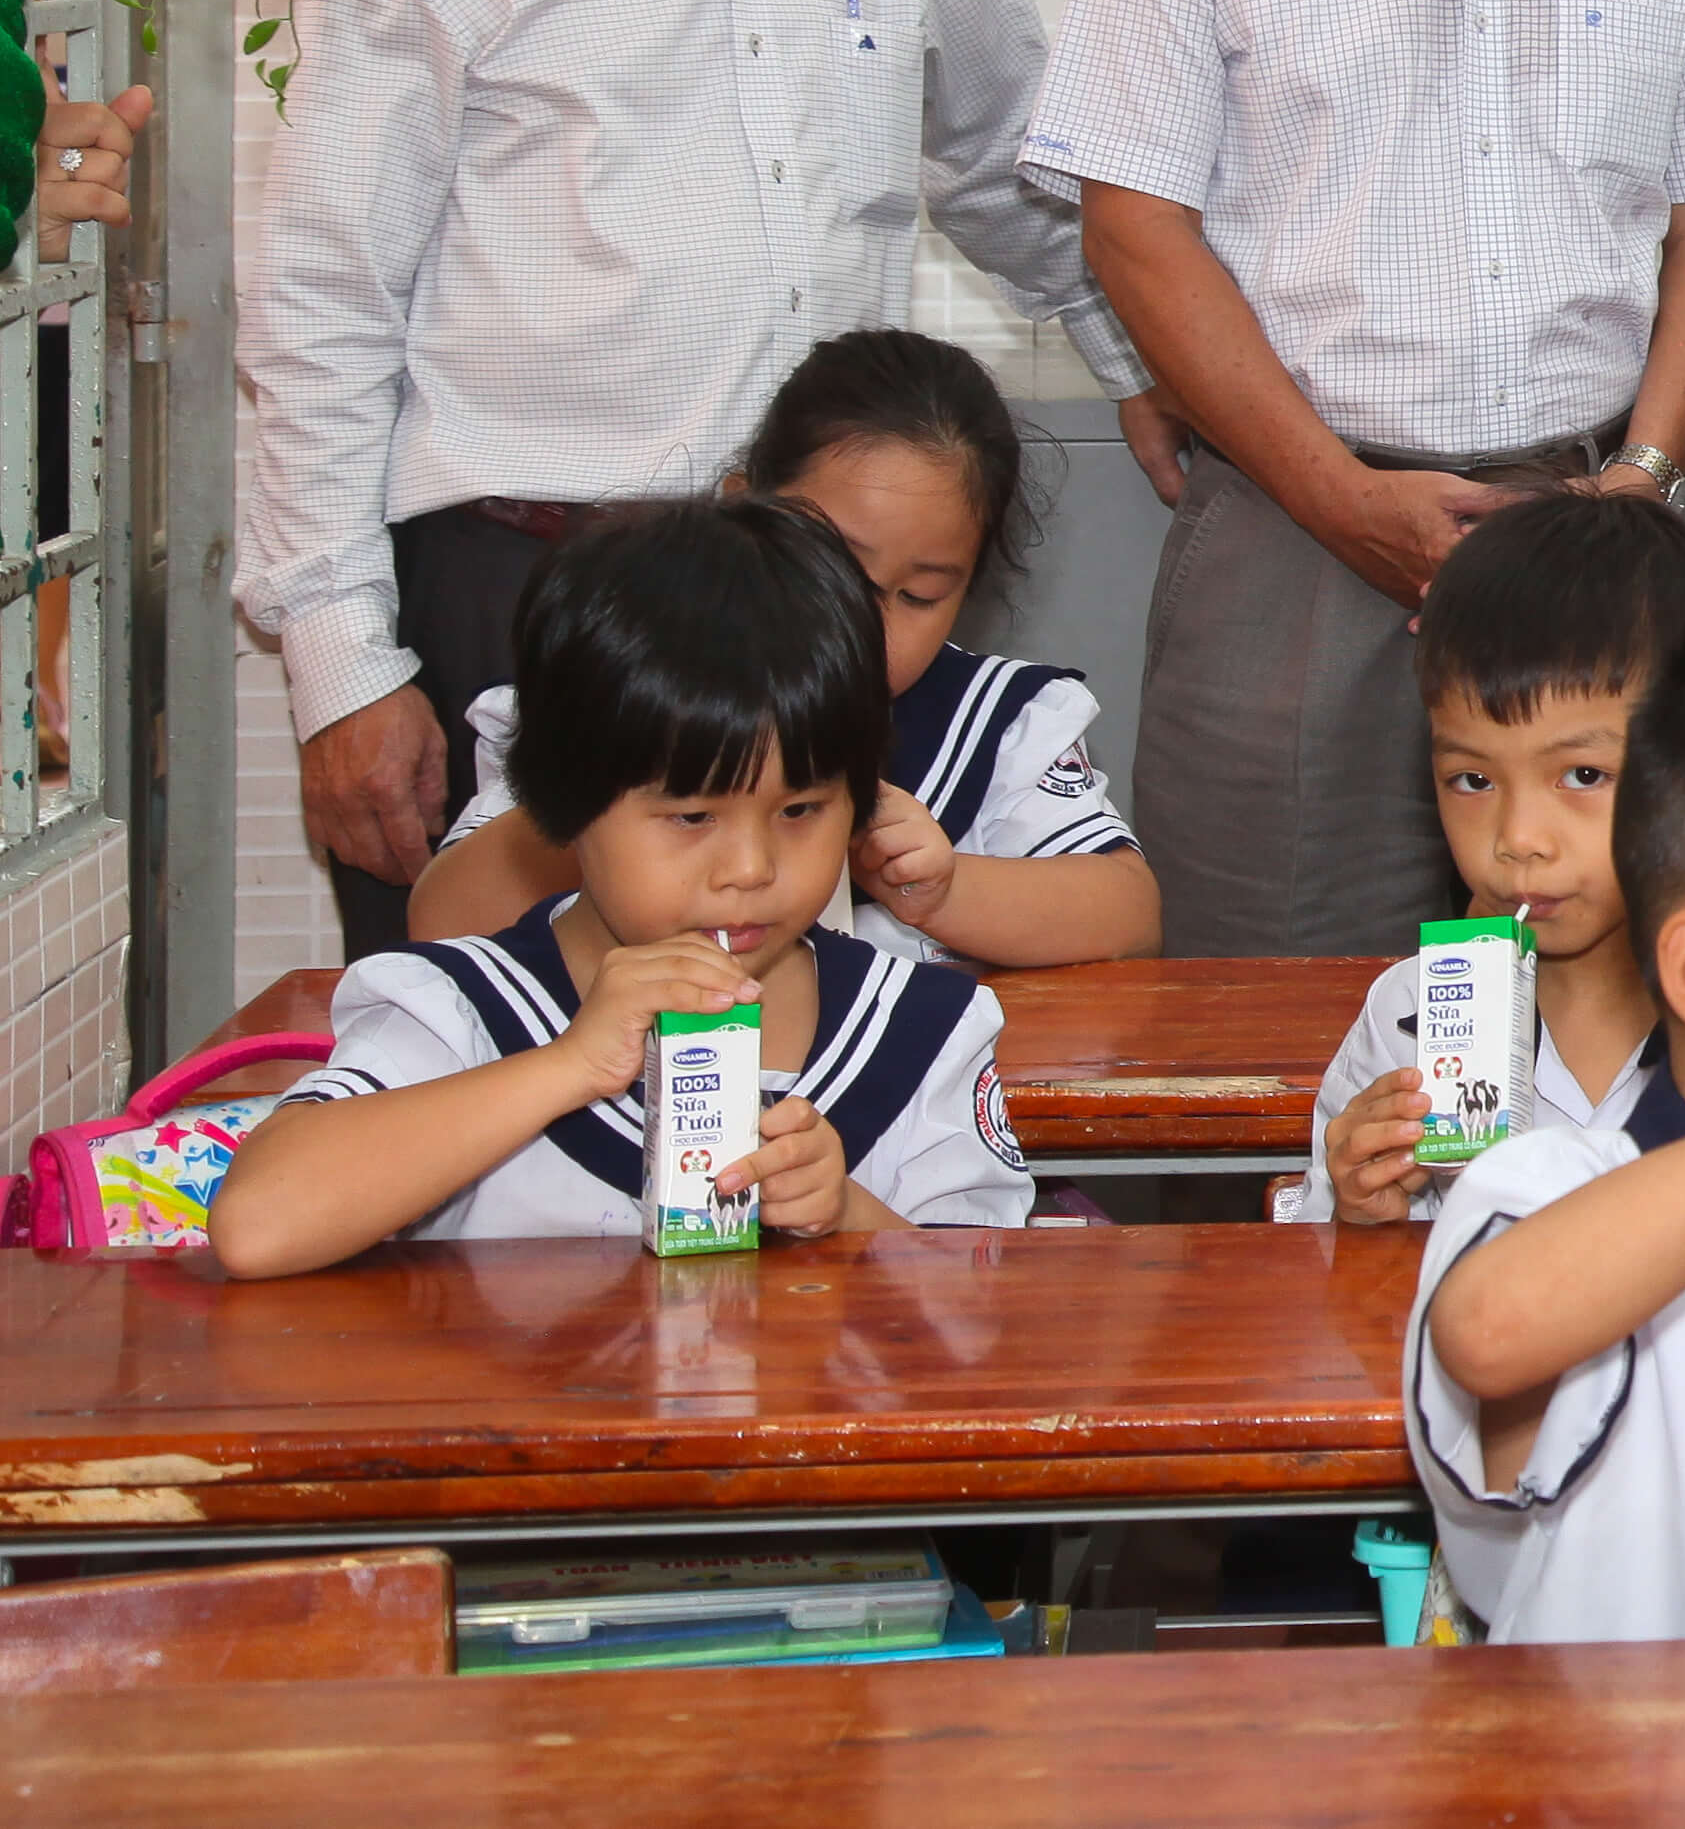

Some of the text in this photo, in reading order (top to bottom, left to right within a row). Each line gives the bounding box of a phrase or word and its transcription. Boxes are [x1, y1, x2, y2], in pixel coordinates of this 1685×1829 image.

[1430, 985, 1472, 1001] 100%
[1427, 1005, 1461, 1022] Sữa
[1427, 1018, 1475, 1039] Tươi
[673, 1076, 719, 1091] 100%
[672, 1096, 708, 1113] Sữa
[672, 1110, 723, 1132] Tươi
